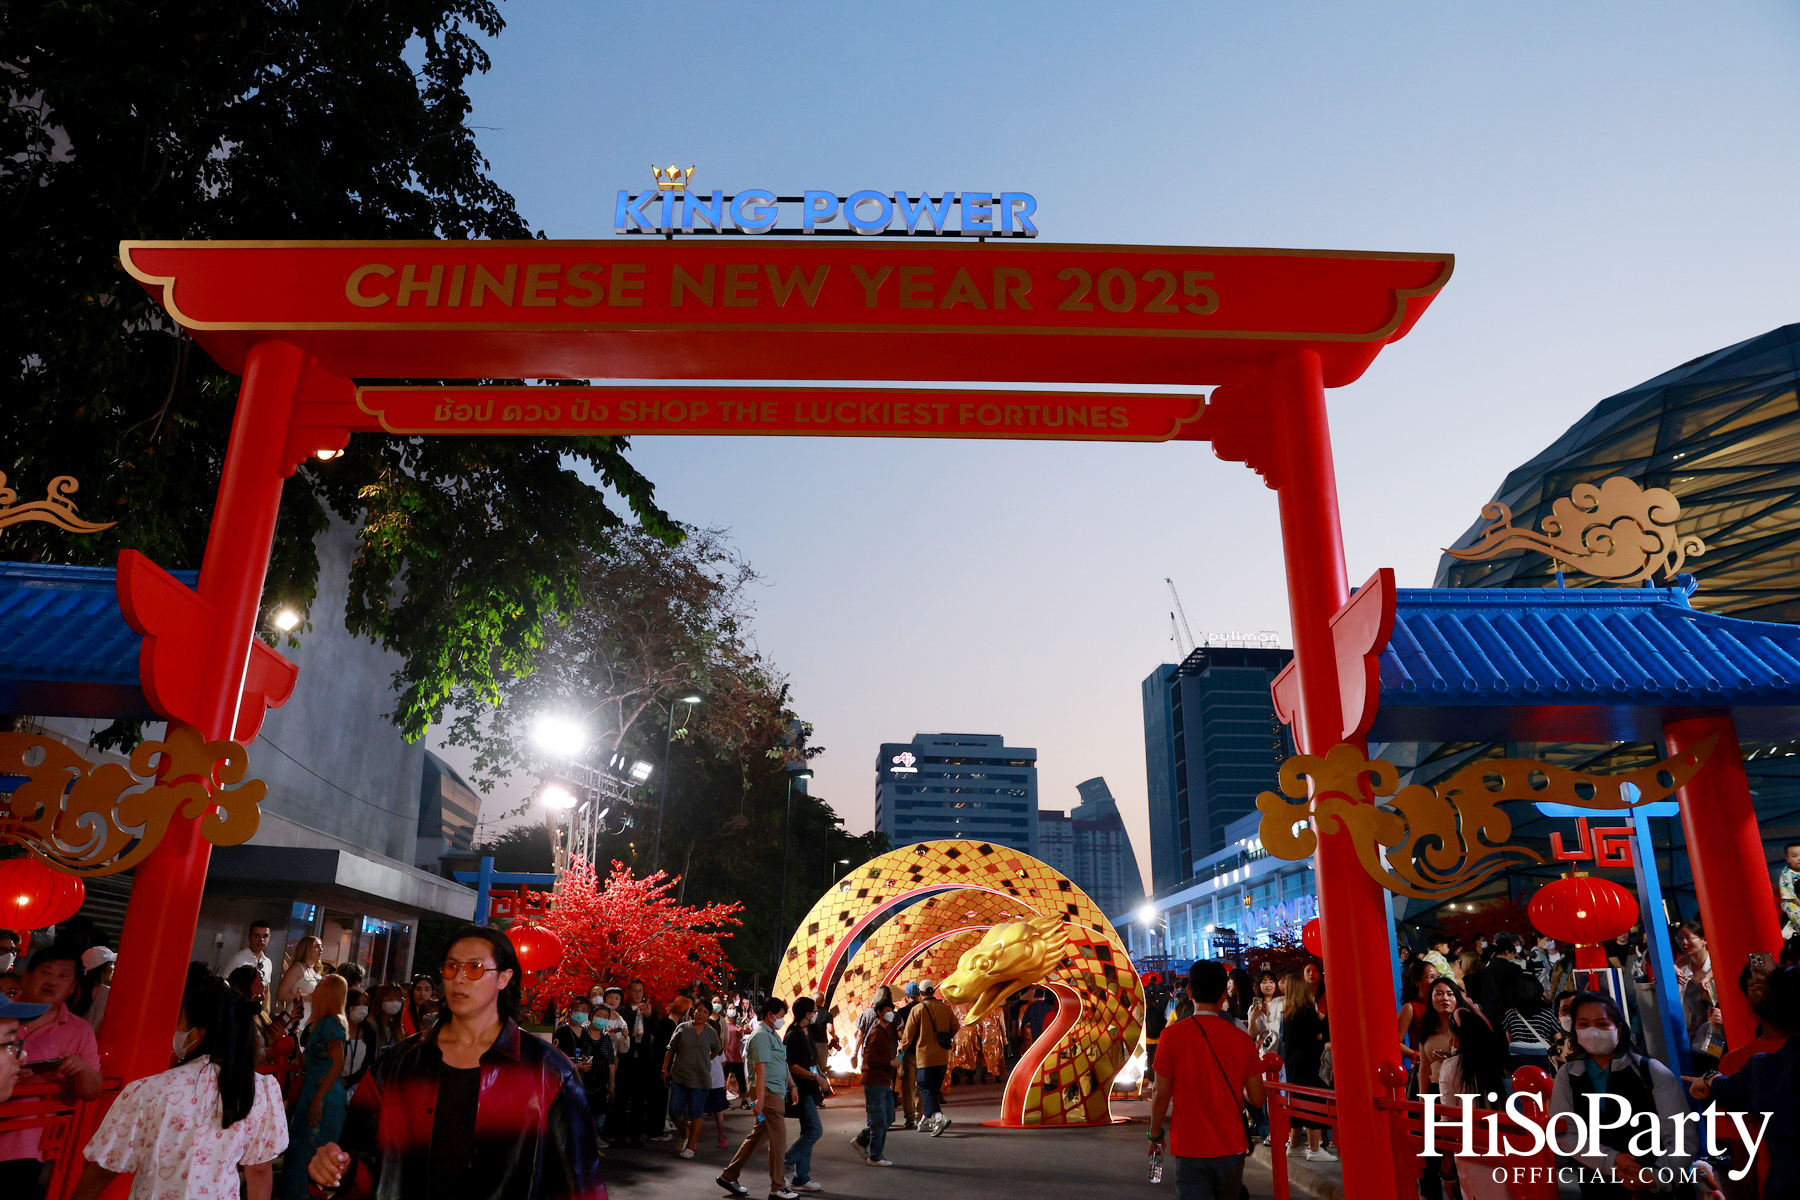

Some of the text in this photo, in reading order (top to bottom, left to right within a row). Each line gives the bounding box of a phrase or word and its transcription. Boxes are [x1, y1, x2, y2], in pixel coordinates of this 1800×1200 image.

[614, 189, 1039, 237] KING POWER
[345, 263, 1220, 316] CHINESE NEW YEAR 2025
[434, 397, 1130, 429] ช้อป ดวง ปัง SHOP THE LUCKIEST FORTUNES
[1208, 631, 1280, 645] pullman
[1240, 894, 1316, 933] KING POWER
